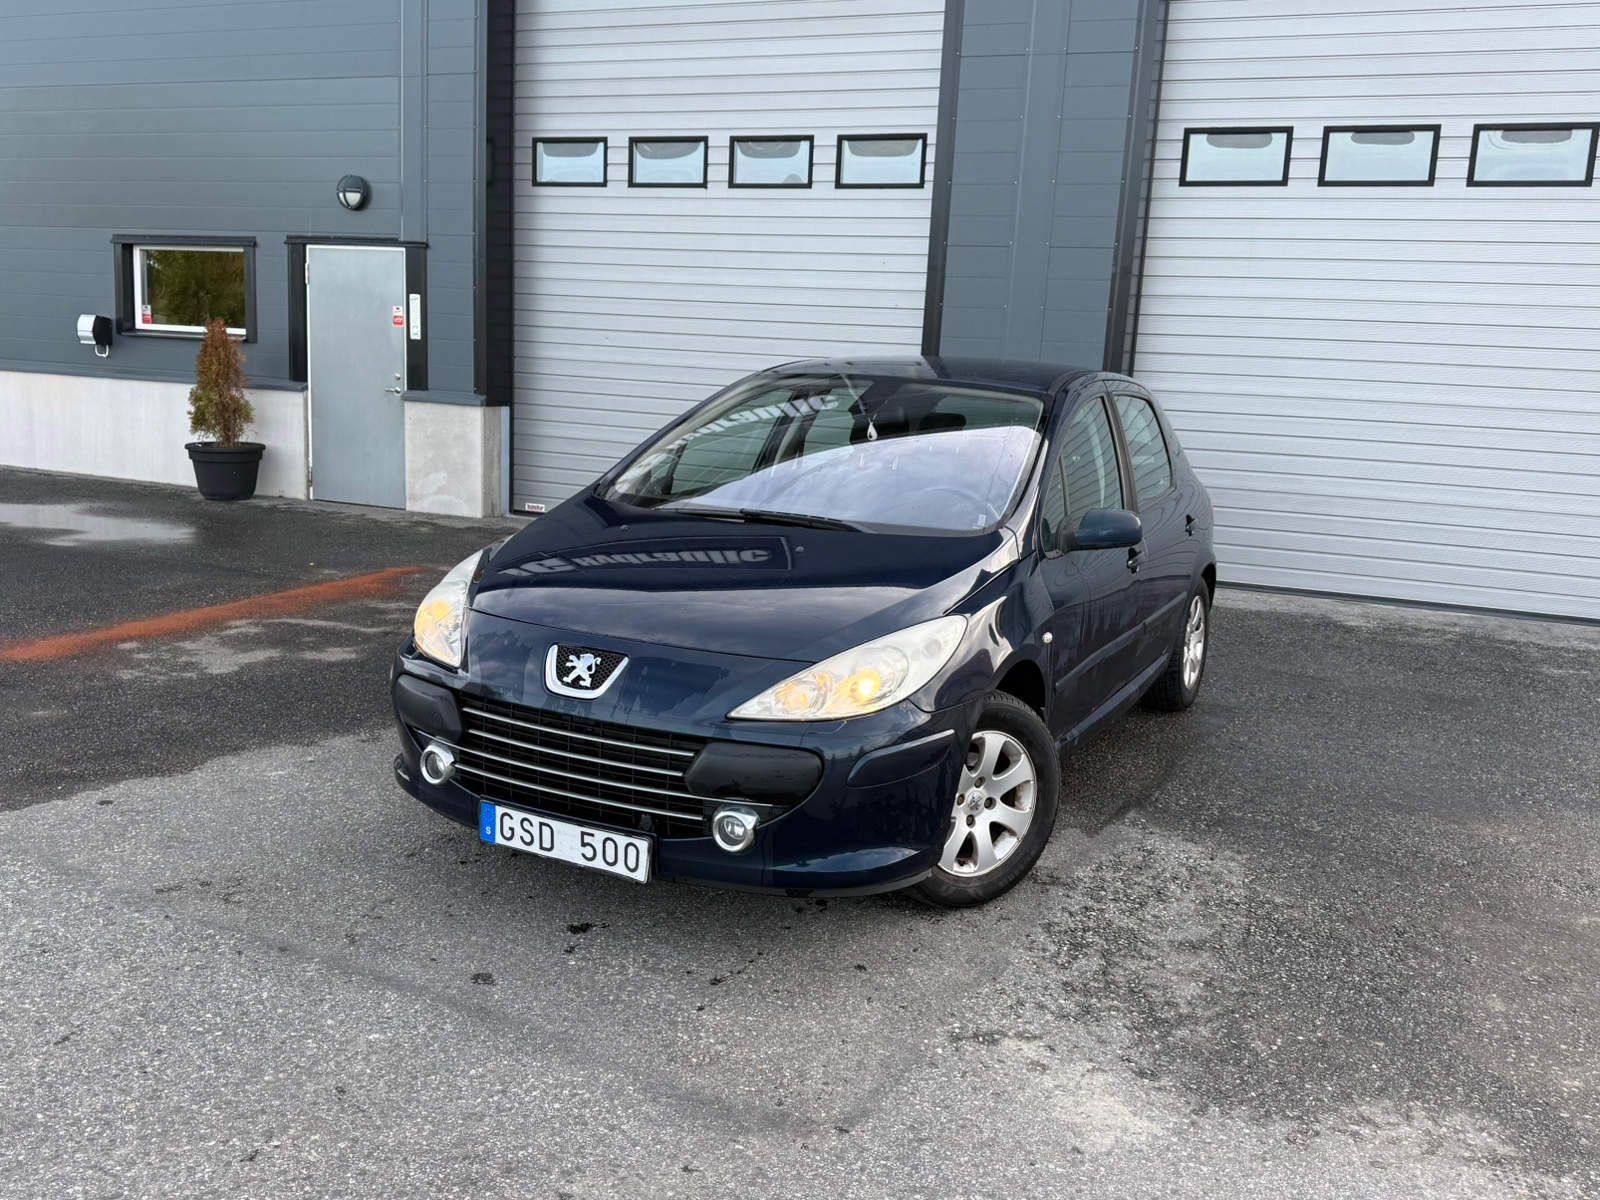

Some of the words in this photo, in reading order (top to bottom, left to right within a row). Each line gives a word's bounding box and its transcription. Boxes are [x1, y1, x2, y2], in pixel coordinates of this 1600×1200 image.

[485, 826, 492, 835] S
[500, 812, 555, 852] GSD
[580, 831, 640, 873] 500
